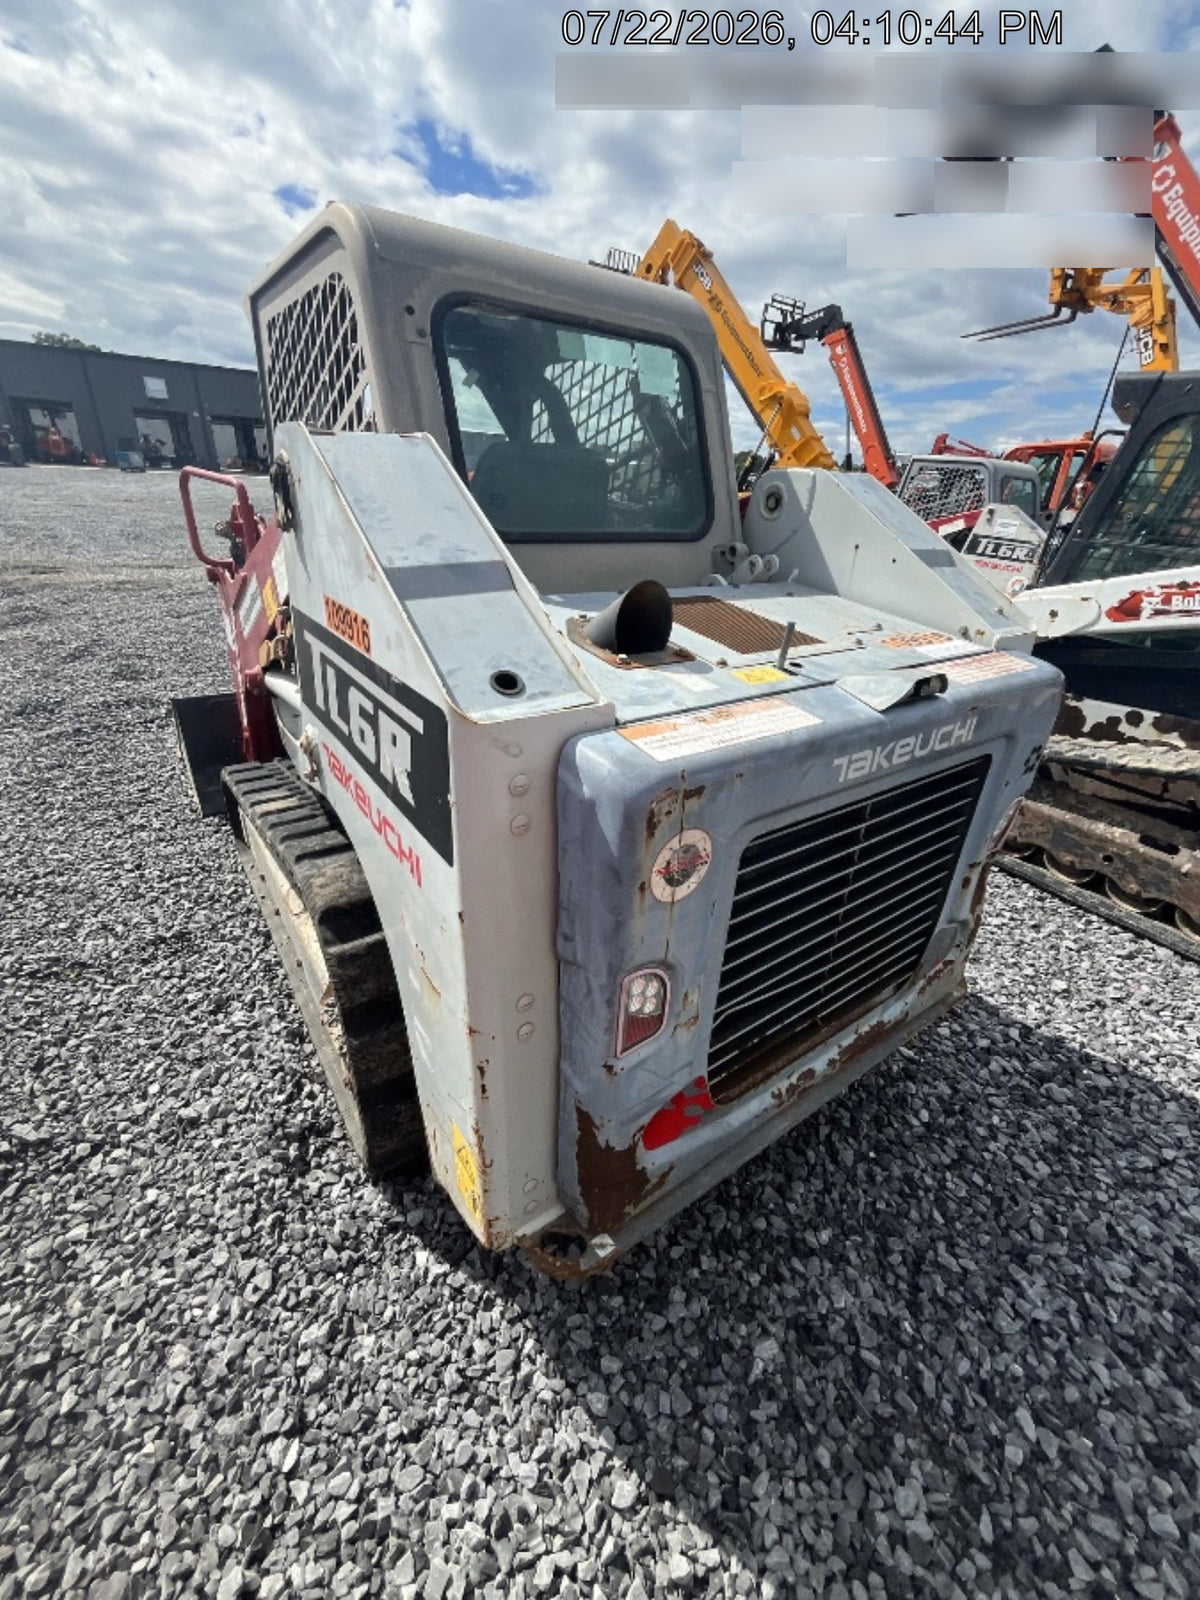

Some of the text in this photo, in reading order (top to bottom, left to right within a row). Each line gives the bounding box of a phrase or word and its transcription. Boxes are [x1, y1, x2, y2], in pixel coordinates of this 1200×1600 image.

[324, 597, 370, 653] 109916
[303, 628, 425, 807] TL6R
[832, 715, 979, 783] TAKEUCHI
[322, 741, 423, 888] TAKEUCHI
